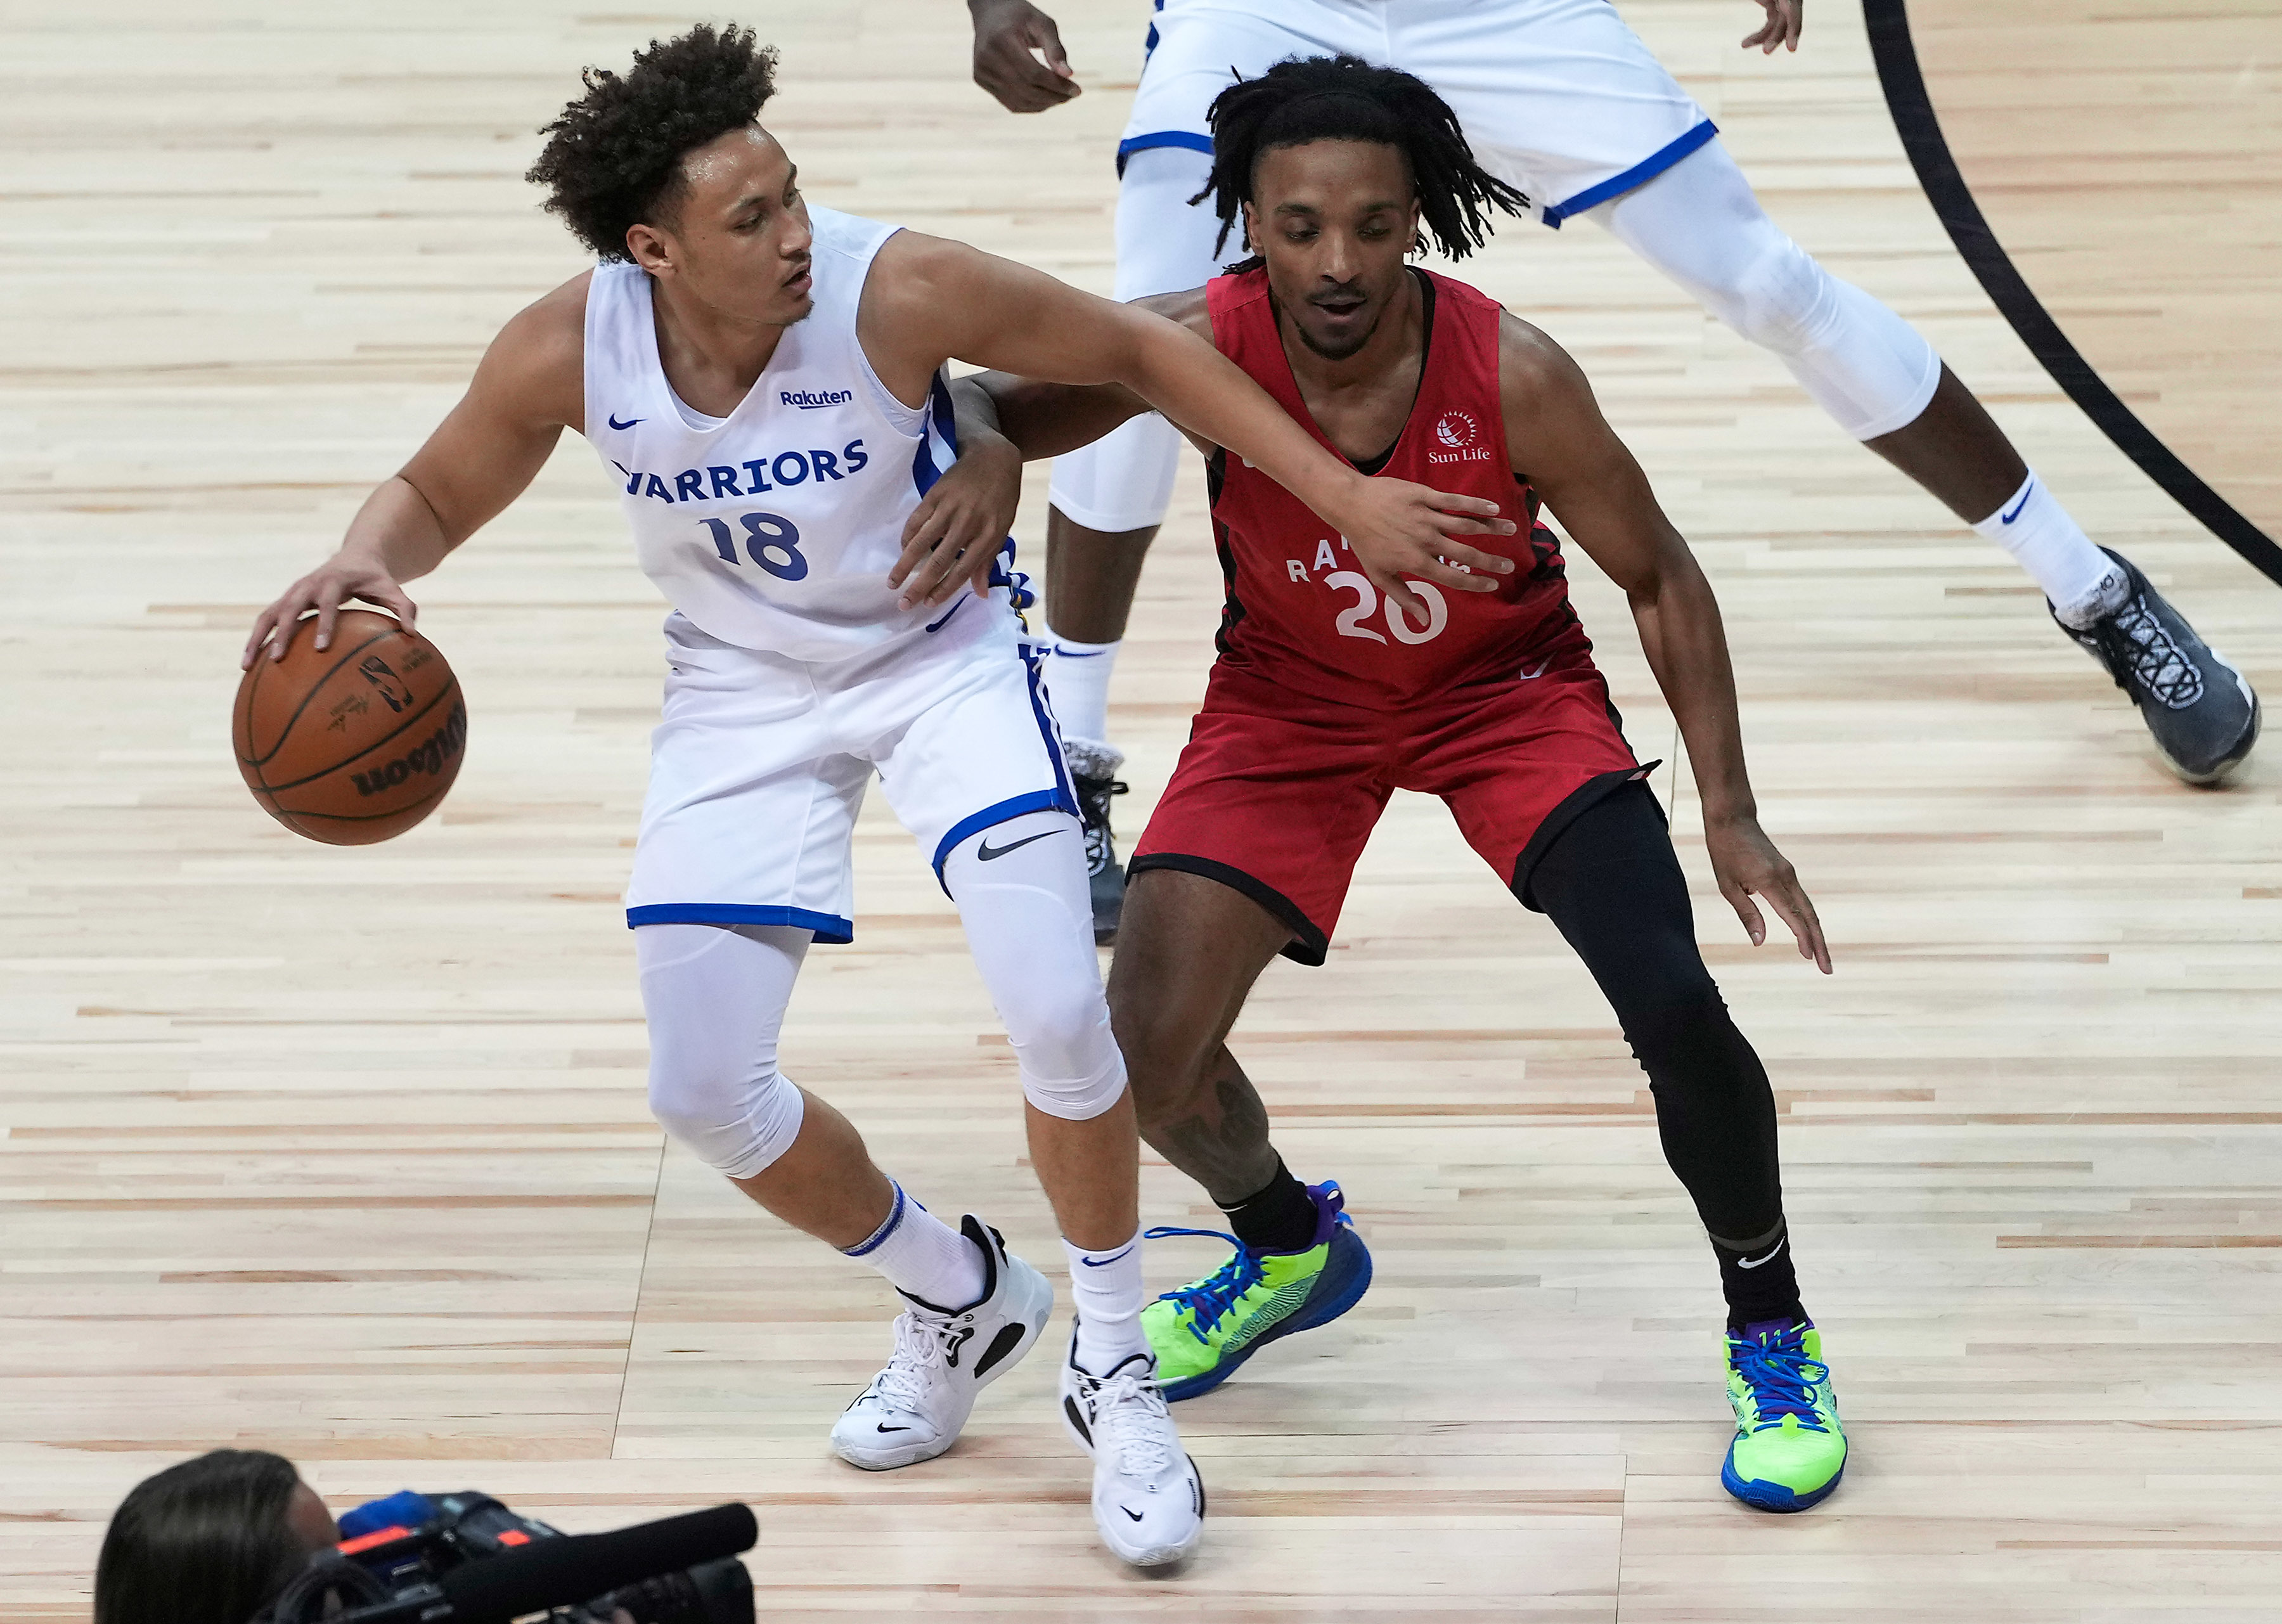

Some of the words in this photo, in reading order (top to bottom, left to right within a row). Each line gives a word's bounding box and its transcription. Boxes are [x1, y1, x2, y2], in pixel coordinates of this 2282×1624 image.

[780, 389, 852, 407] Rakuten
[1429, 451, 1459, 463] Sun
[1462, 448, 1490, 461] Life
[696, 512, 808, 581] 18
[1324, 570, 1448, 645] 20
